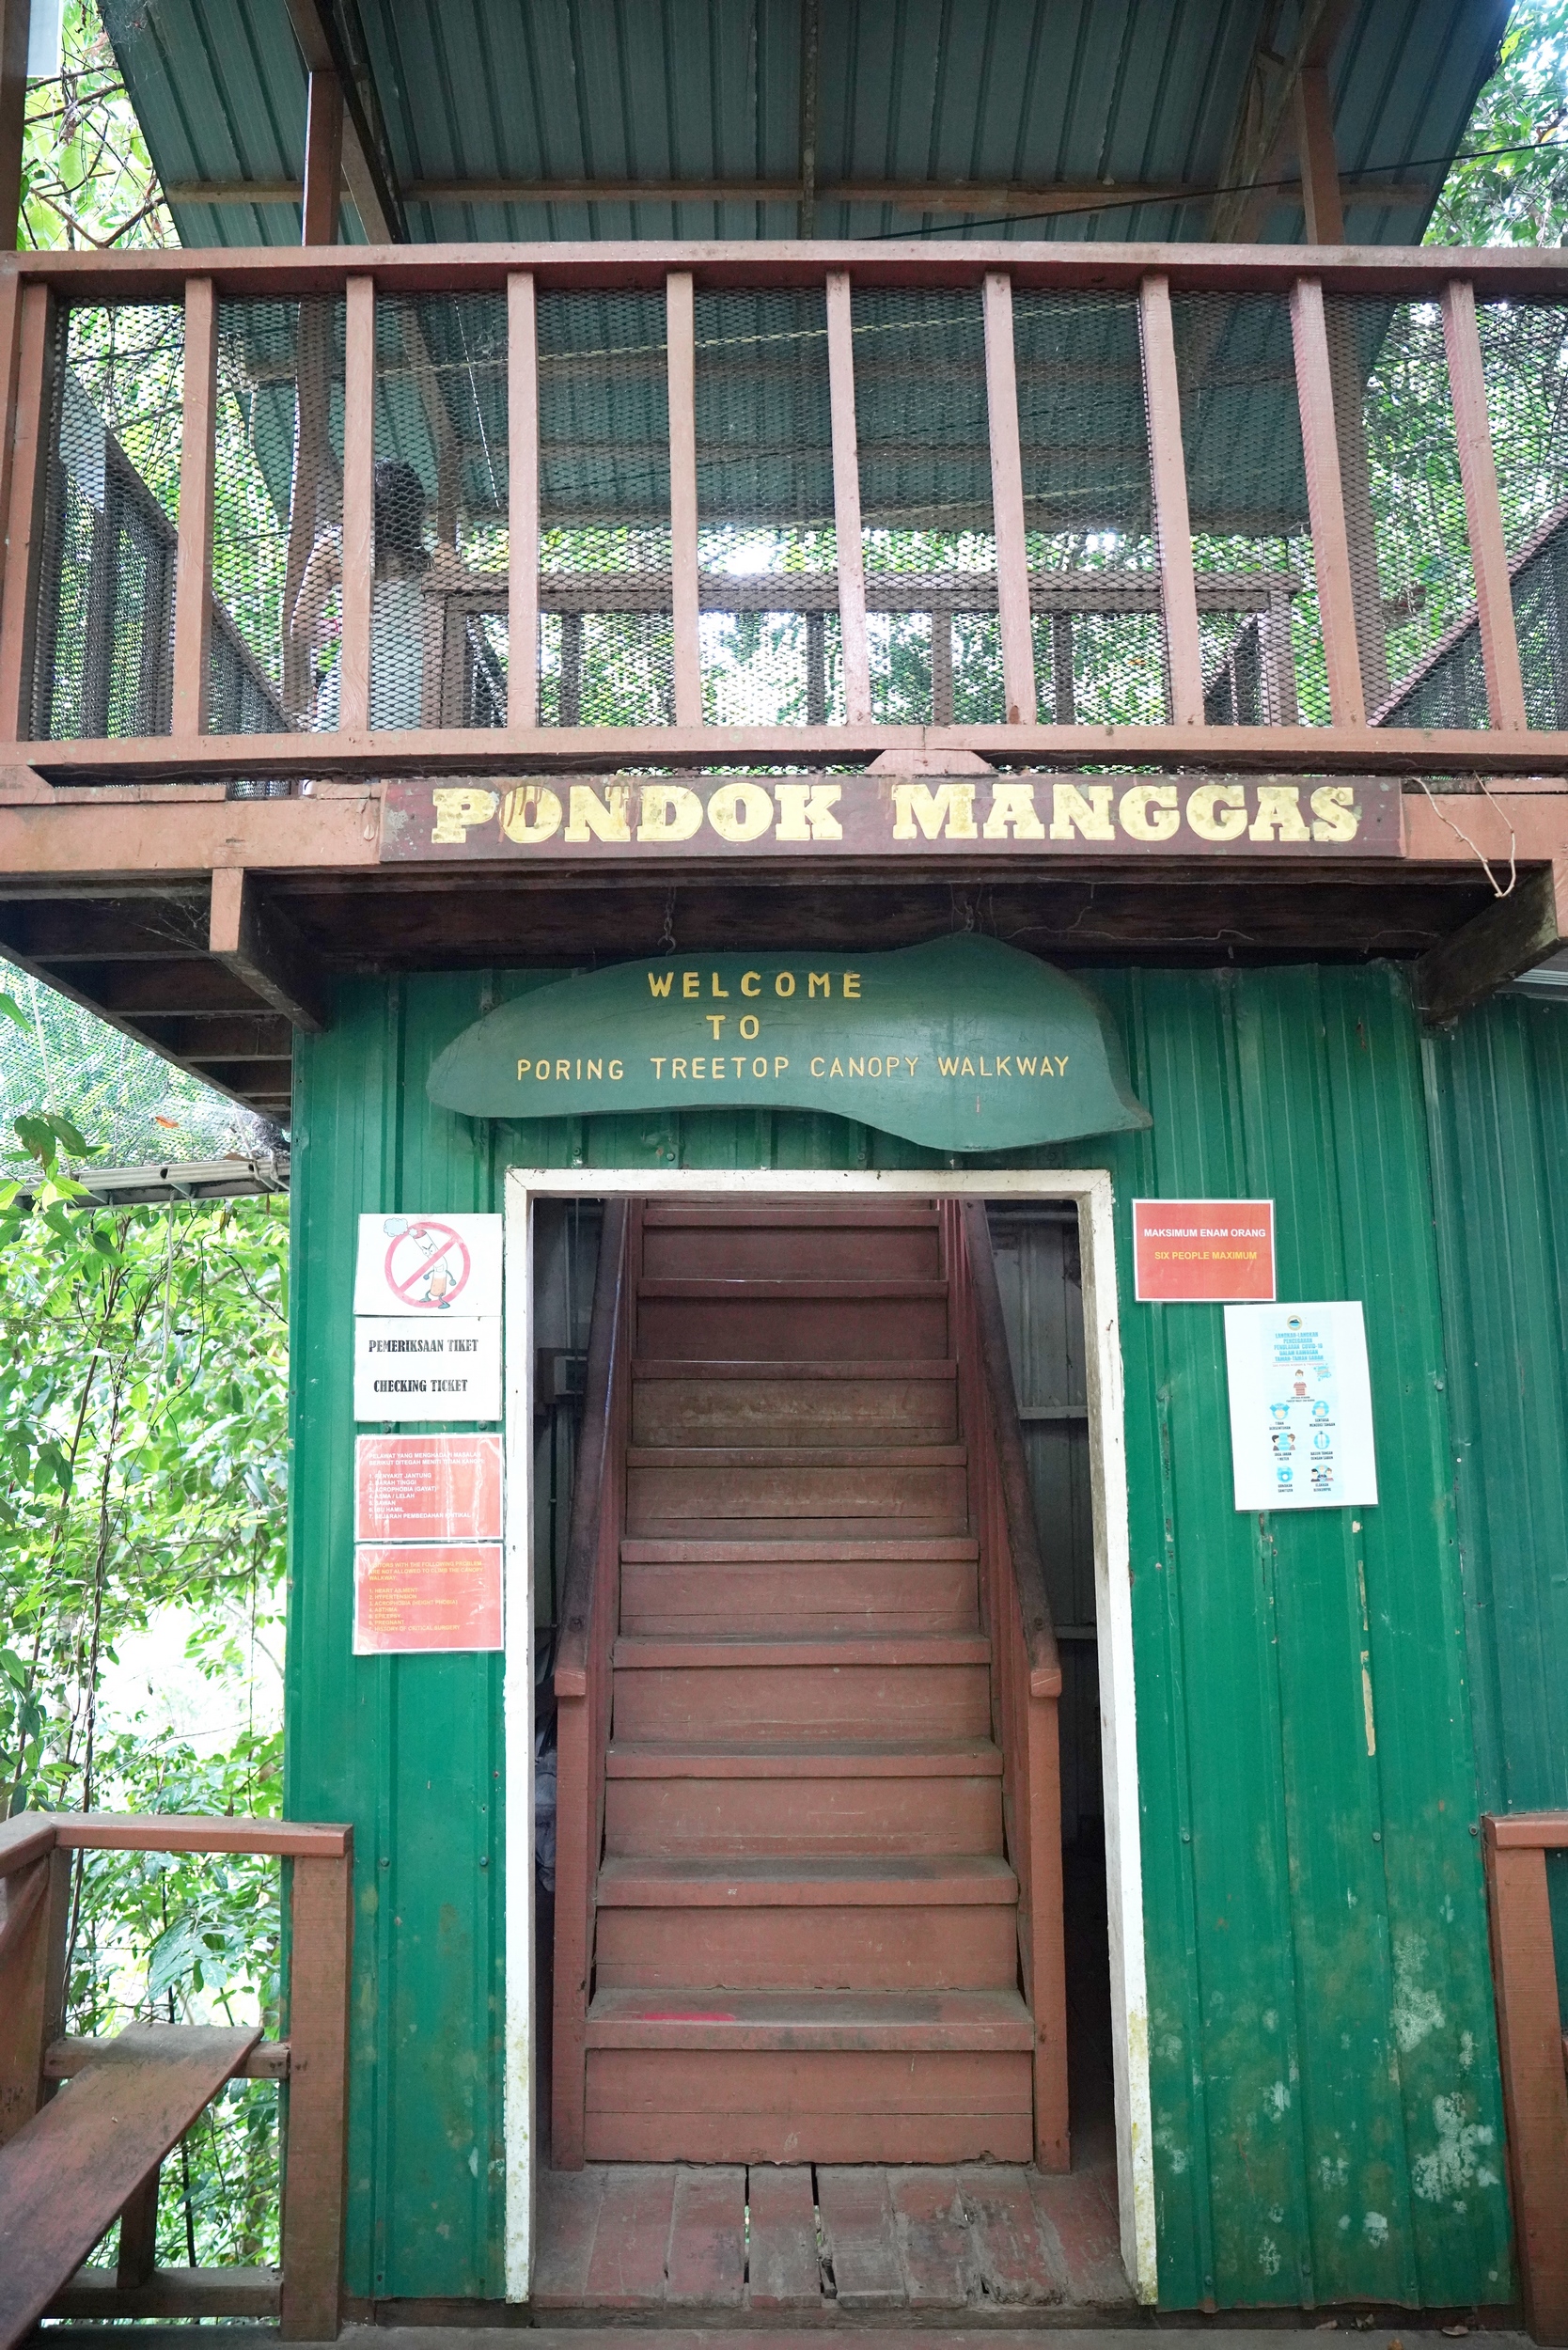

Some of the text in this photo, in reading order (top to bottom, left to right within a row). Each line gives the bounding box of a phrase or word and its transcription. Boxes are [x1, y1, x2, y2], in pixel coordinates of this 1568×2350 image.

[431, 783, 1358, 843] PONDOK MANGGAS
[648, 971, 862, 998] WELCOME
[706, 1015, 760, 1040] TO
[517, 1056, 1071, 1080] PORING TREETOP CANOPY WALKWAY
[1144, 1229, 1266, 1237] MAKSIMUM ENAM ORANG
[368, 1339, 479, 1353] PEMERIKSAAN TIKET
[374, 1379, 468, 1392] CHECKING TICKET
